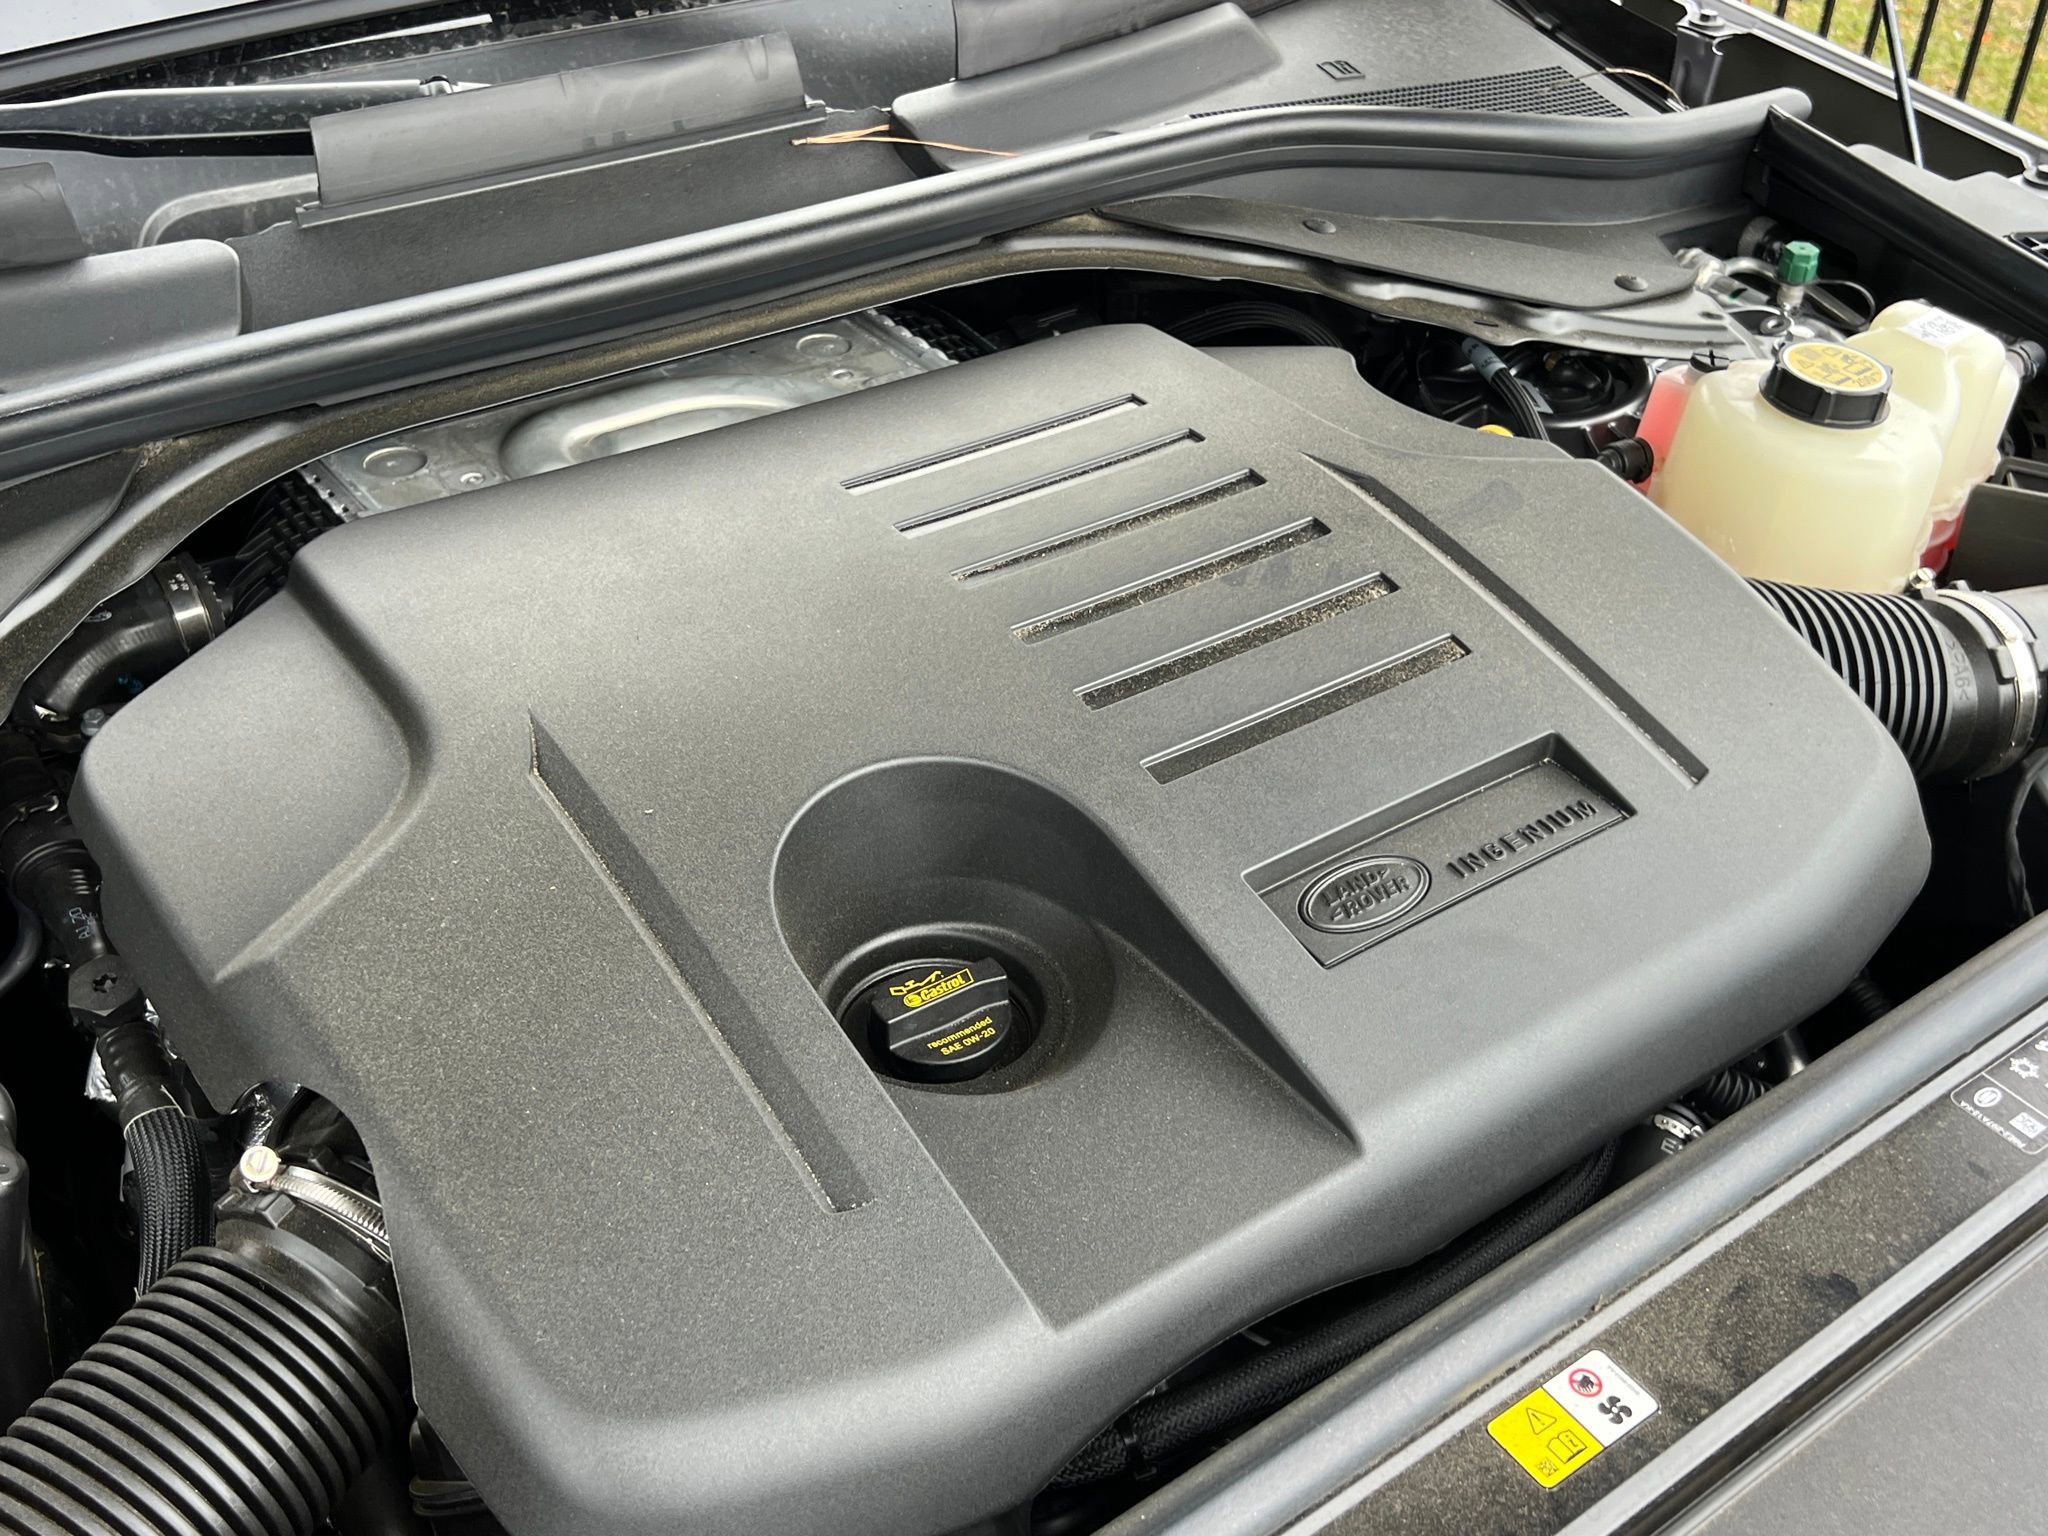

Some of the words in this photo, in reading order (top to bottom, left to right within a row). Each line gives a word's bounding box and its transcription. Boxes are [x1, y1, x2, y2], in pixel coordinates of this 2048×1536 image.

[1446, 800, 1599, 879] INGENIUM
[1320, 870, 1381, 906] LAND
[1341, 875, 1410, 920] ROVER
[920, 975, 965, 1000] Castrol
[927, 1016, 992, 1049] recommended
[940, 1042, 963, 1056] SAE
[963, 1027, 995, 1046] 0W-20
